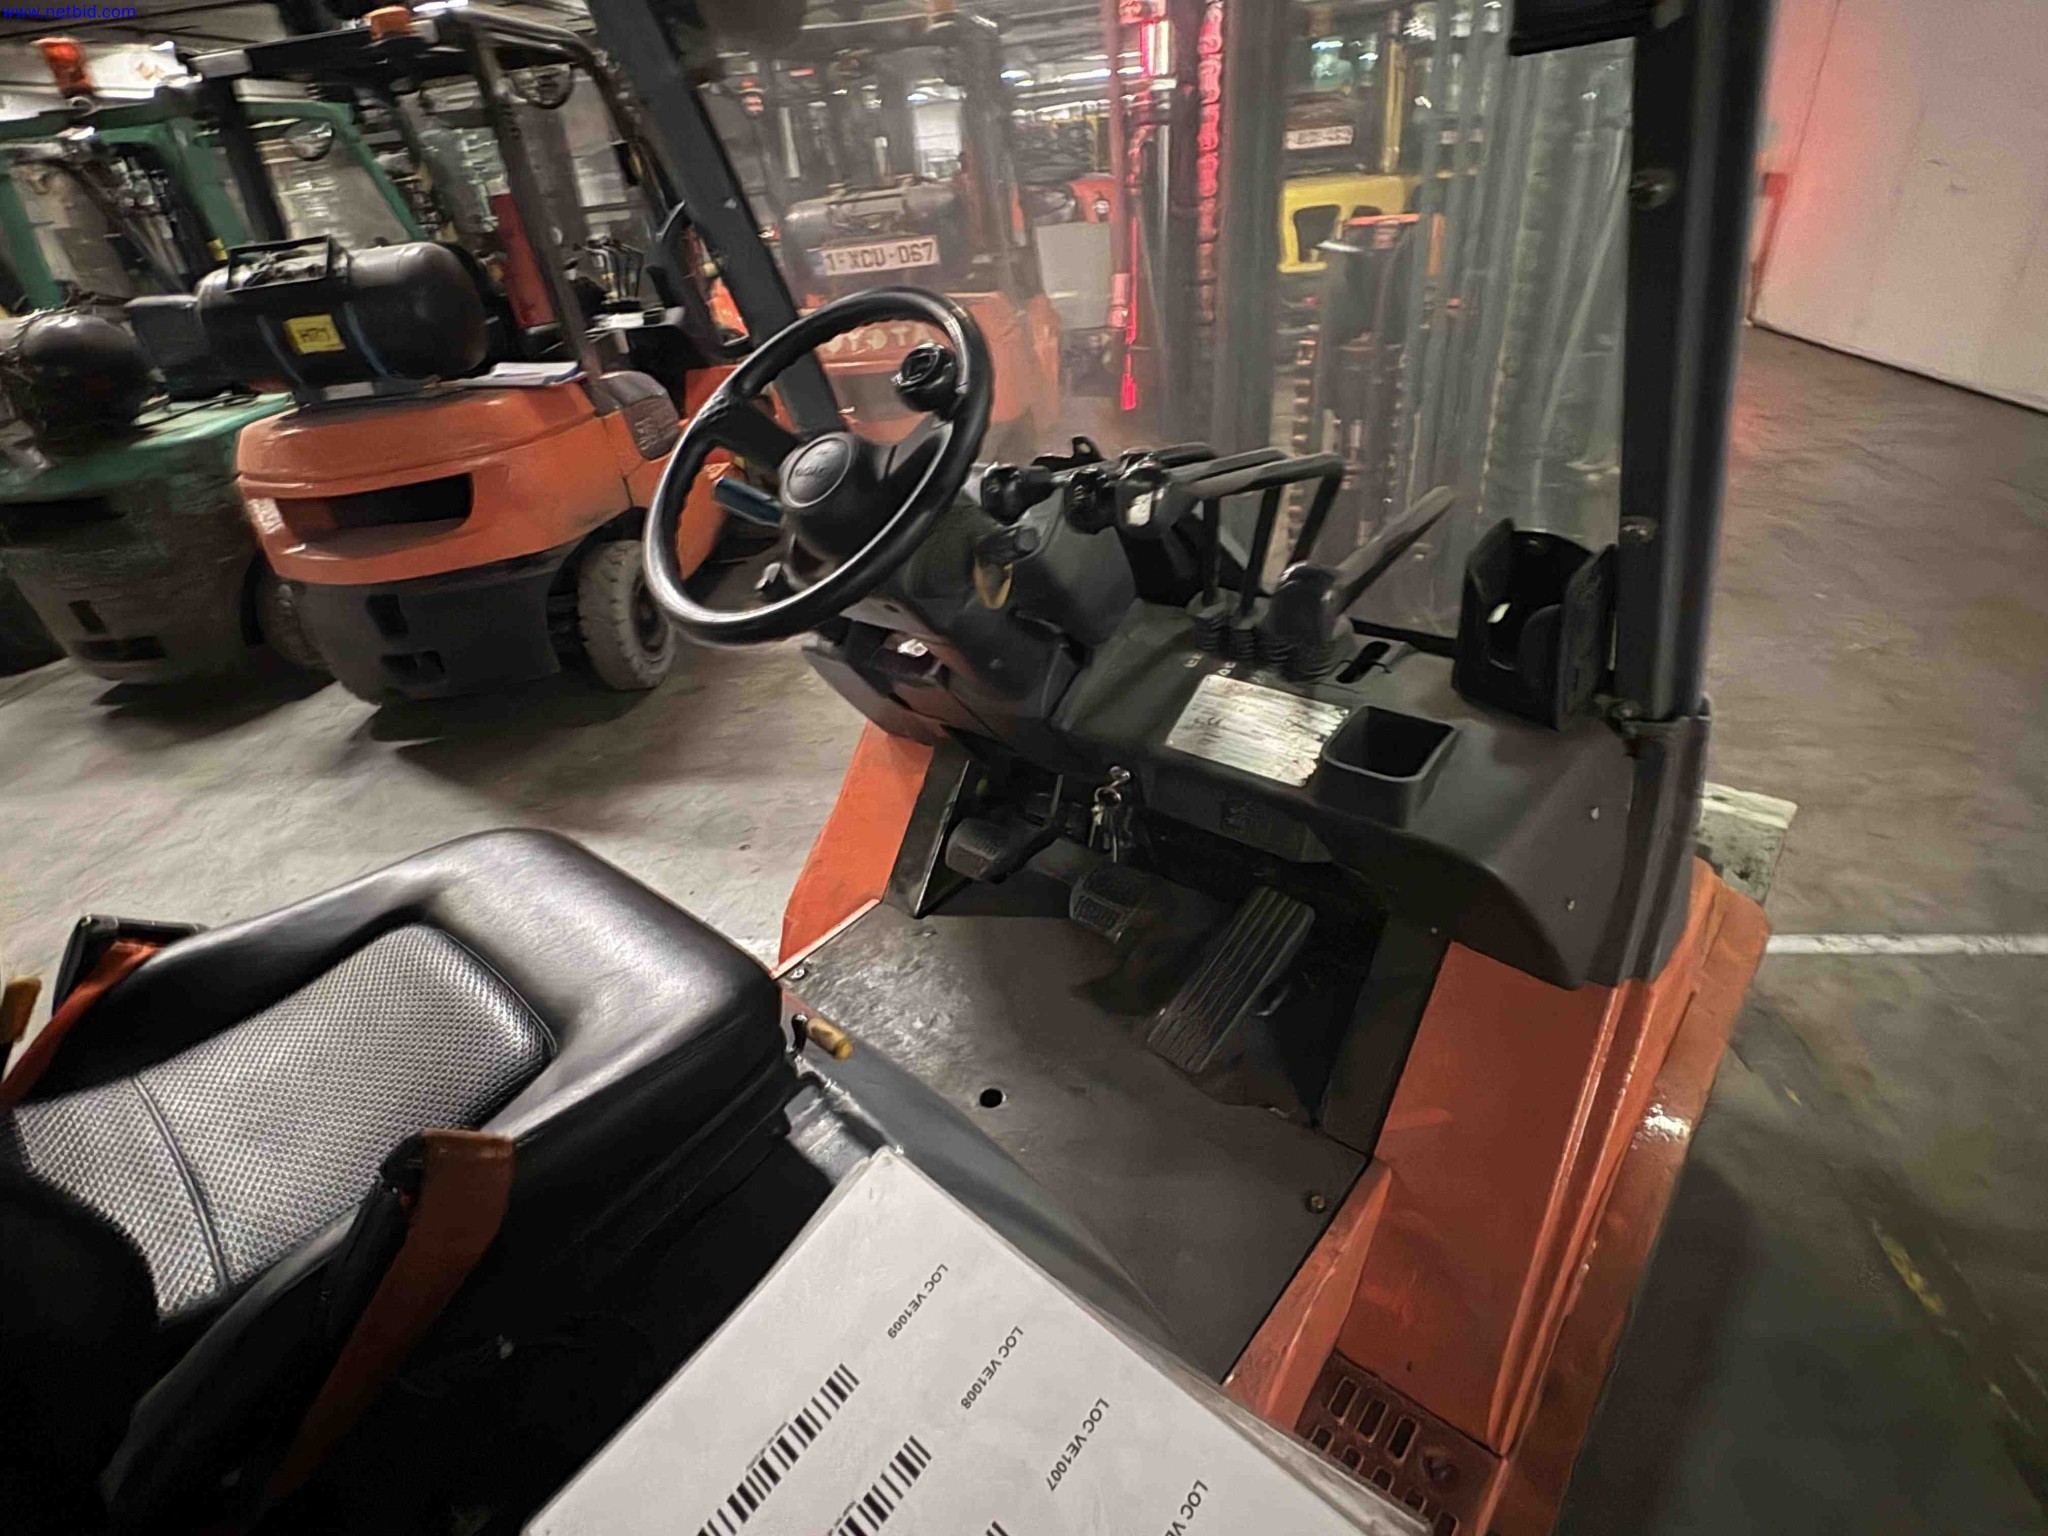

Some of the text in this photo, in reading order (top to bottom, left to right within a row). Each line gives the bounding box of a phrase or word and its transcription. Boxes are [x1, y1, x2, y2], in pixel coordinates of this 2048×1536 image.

[887, 1263, 949, 1339] LOC VE1009
[960, 1325, 1024, 1410] LOC VE1008
[1046, 1398, 1110, 1492] LOC VE1007
[1180, 1479, 1209, 1520] LOC
